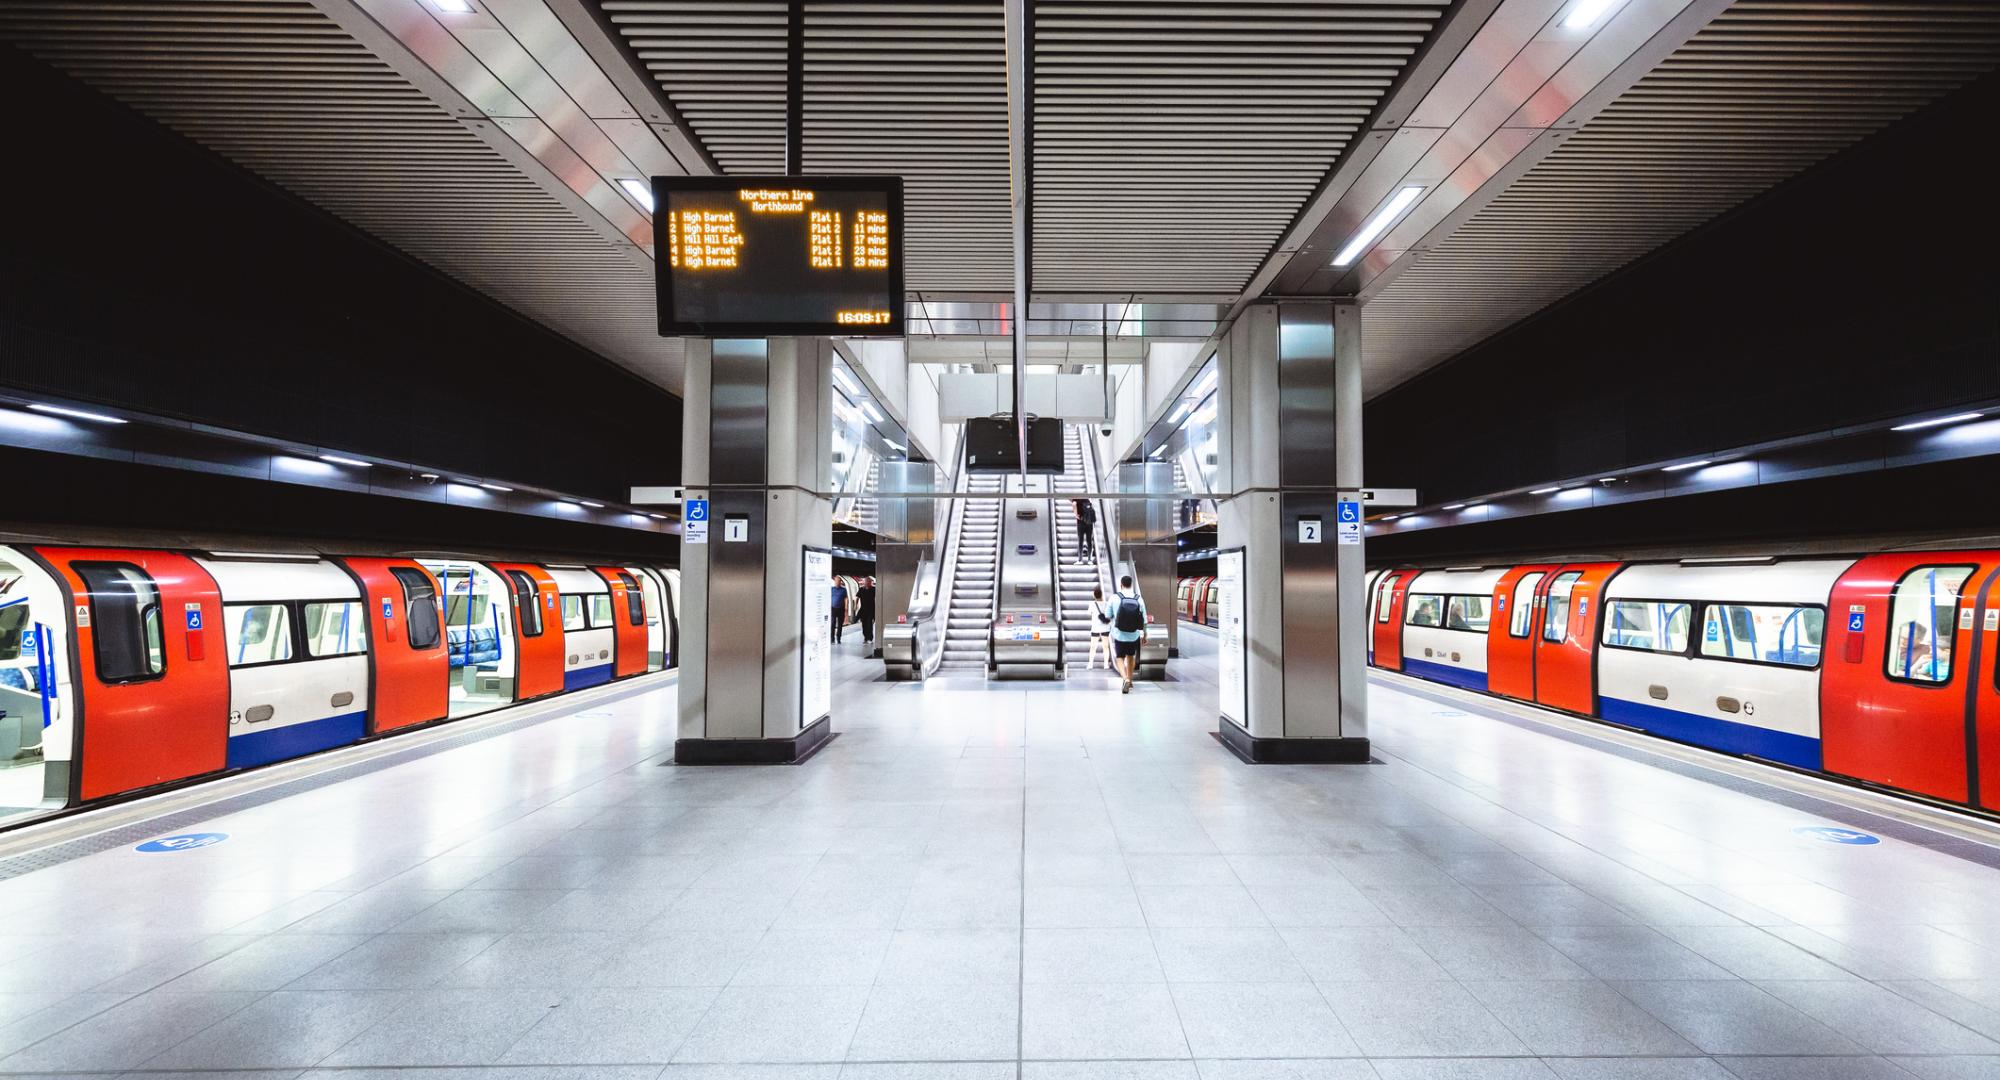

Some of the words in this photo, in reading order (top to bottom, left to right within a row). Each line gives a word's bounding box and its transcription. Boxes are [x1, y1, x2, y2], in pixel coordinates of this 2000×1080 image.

[740, 189, 789, 201] Northern
[791, 189, 815, 201] line
[752, 201, 804, 212] Northbound
[670, 211, 677, 222] 1
[682, 211, 702, 224] High
[703, 211, 736, 222] Barnet
[810, 211, 832, 222] Plat
[834, 211, 841, 222] 1
[858, 212, 865, 222] 5
[866, 212, 887, 222] mins
[669, 223, 677, 233] 2
[683, 223, 703, 235] High
[704, 223, 736, 233] Barnet
[810, 223, 832, 234] Plat
[834, 223, 841, 233] 2
[854, 223, 865, 234] 11
[867, 224, 887, 234] mins
[670, 234, 677, 244] 3
[684, 234, 702, 244] Mill
[703, 234, 720, 244] Hill
[722, 233, 745, 245] East
[811, 234, 832, 245] Plat
[834, 234, 841, 245] 1
[854, 234, 865, 245] 17
[867, 235, 887, 245] mins
[671, 245, 678, 255] 4
[684, 245, 703, 257] High
[705, 245, 737, 255] Barnet
[811, 245, 833, 256] Plat
[834, 245, 841, 256] 2
[867, 246, 888, 256] mins
[671, 256, 678, 267] 5
[685, 256, 704, 268] High
[706, 256, 737, 267] Barnet
[811, 256, 833, 267] Plat
[835, 256, 842, 267] 1
[867, 257, 888, 267] mins
[837, 312, 891, 324] 16:09:17
[733, 525, 738, 538] 1
[1306, 526, 1314, 539] 2
